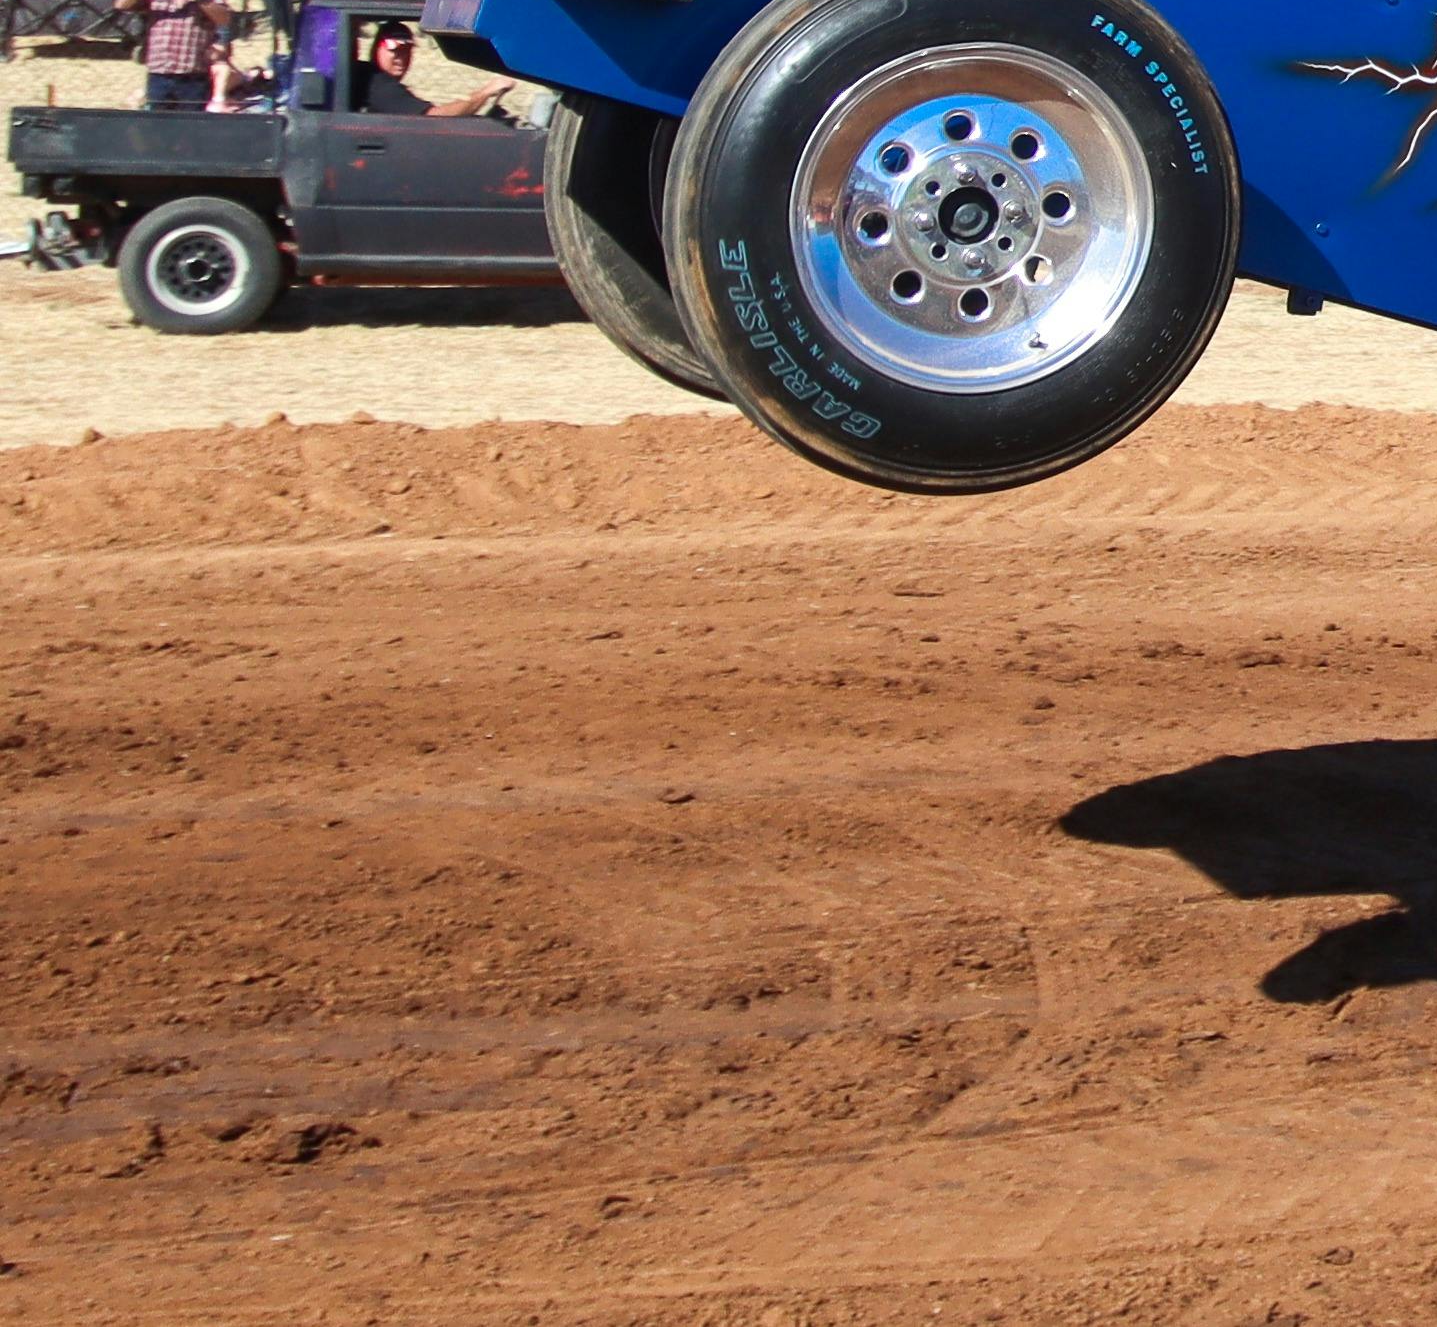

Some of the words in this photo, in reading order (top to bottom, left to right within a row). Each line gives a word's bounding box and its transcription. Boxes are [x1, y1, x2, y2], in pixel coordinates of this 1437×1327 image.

[1090, 14, 1143, 58] FARM
[1145, 61, 1208, 174] SPECIALIST
[719, 239, 881, 439] CARLISLE
[787, 316, 811, 345] THE
[808, 343, 825, 361] IN
[826, 361, 862, 392] MADE
